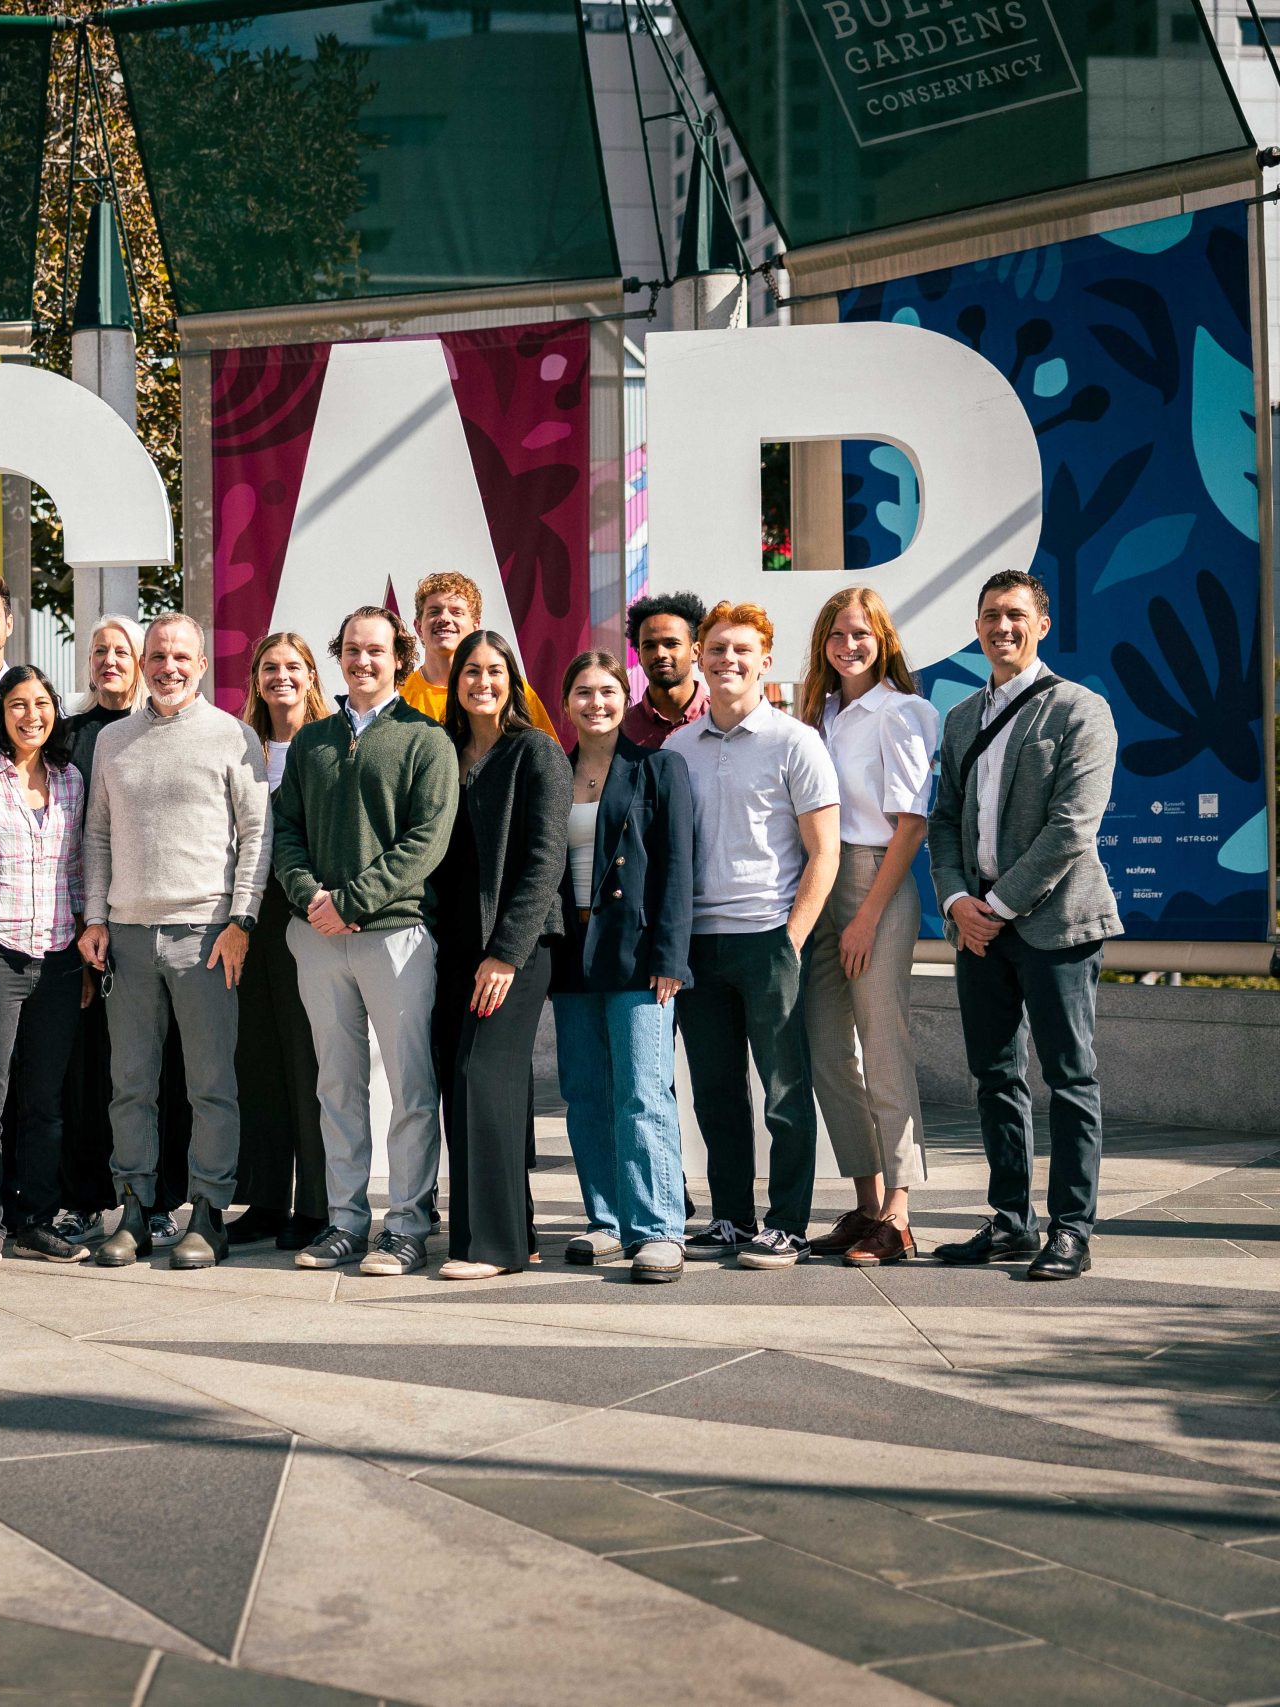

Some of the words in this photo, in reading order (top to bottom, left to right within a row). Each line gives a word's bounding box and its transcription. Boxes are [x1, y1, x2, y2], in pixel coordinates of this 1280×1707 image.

[822, 0, 954, 40] BU
[844, 1, 1027, 74] GARDENS
[866, 54, 1043, 115] CONSERVANCY
